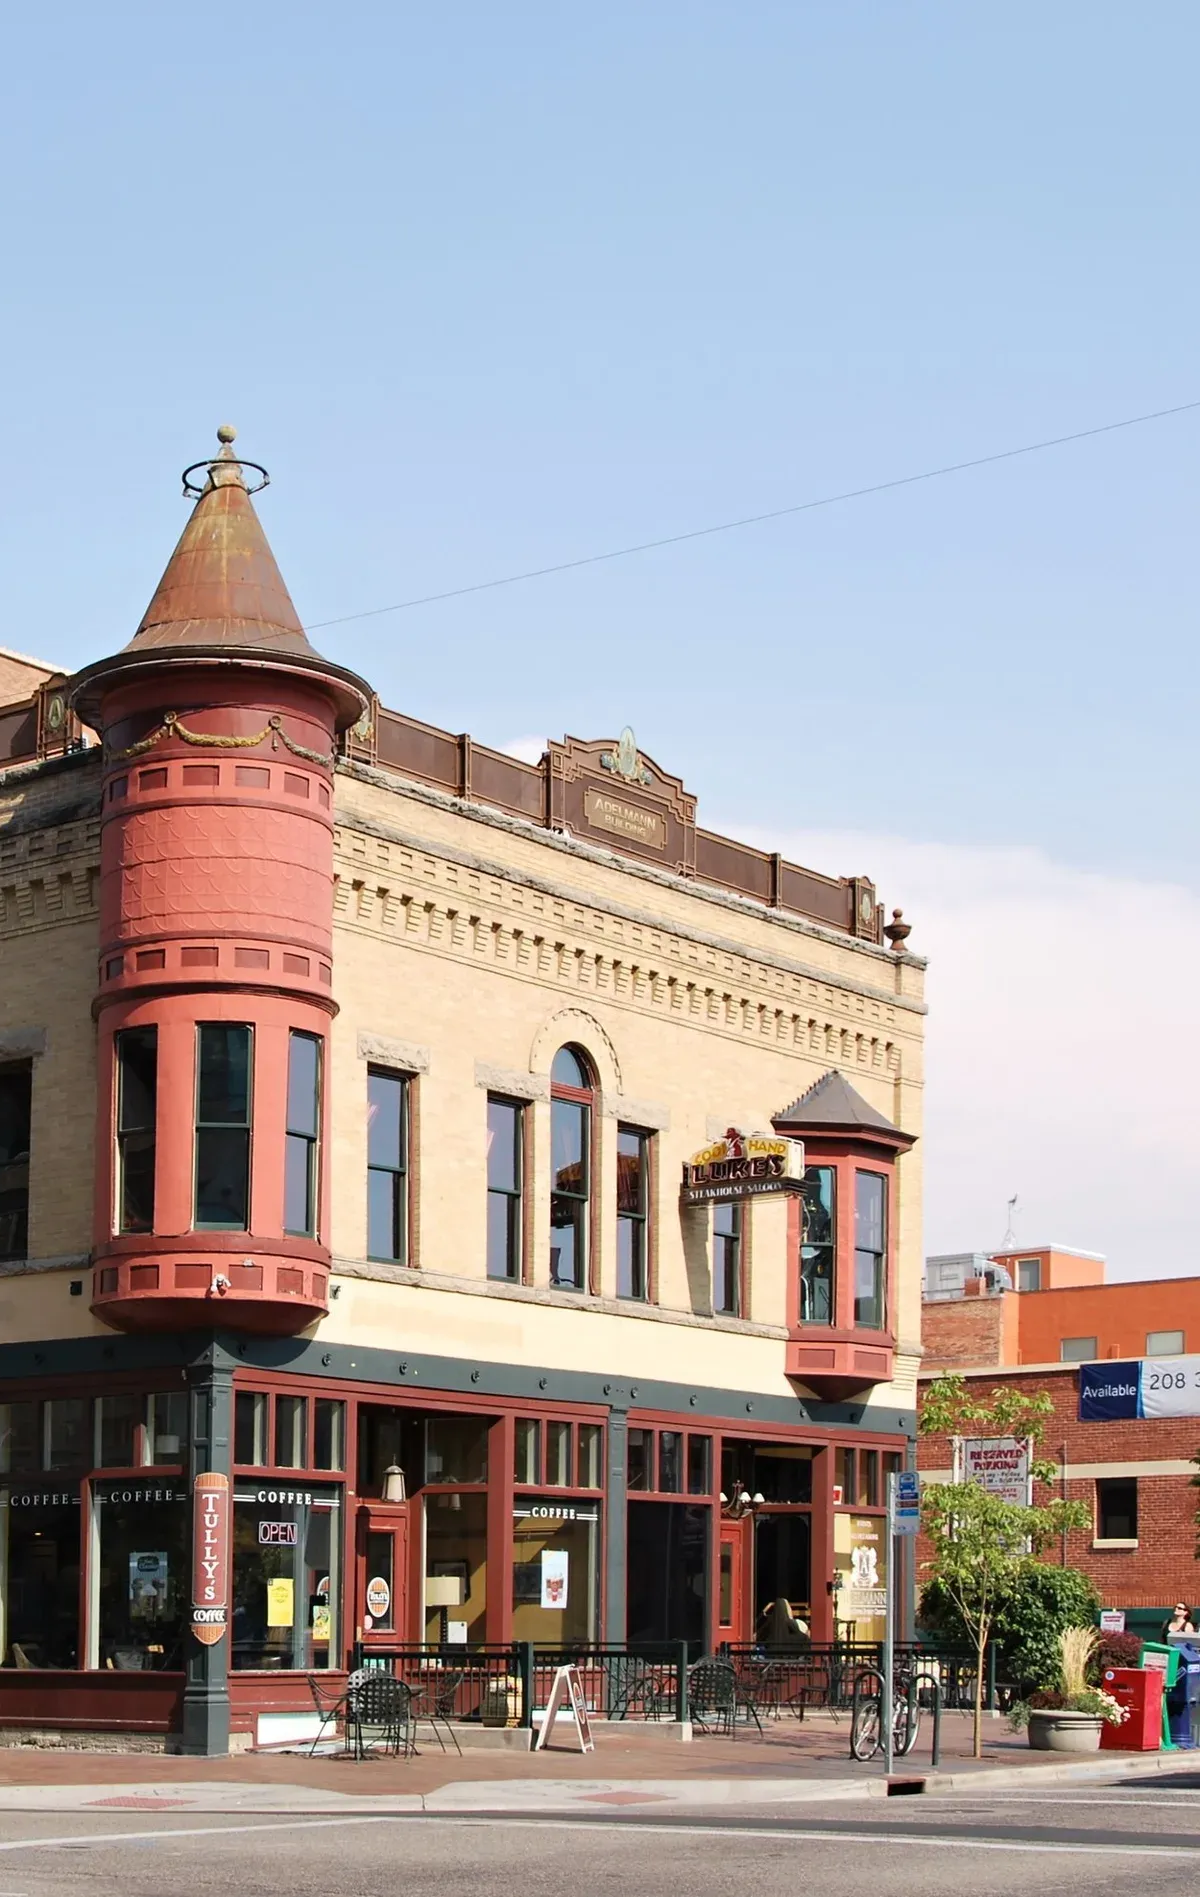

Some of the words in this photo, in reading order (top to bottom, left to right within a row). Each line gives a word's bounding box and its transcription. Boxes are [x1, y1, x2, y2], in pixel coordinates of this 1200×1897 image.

[595, 799, 655, 830] ADELMANN
[605, 815, 646, 837] BUILDING
[748, 1140, 787, 1154] HAND
[689, 1186, 743, 1199] STEAKHOUSE
[747, 1181, 782, 1194] SALOON
[1082, 1383, 1137, 1398] Available
[1150, 1372, 1186, 1391] 208
[10, 1493, 69, 1507] COFFEE
[110, 1490, 173, 1503] COFFEE
[257, 1490, 312, 1505] COFFEE
[531, 1506, 576, 1520] COFFEE
[260, 1523, 296, 1543] OPEN
[201, 1493, 220, 1600] TULLY'S
